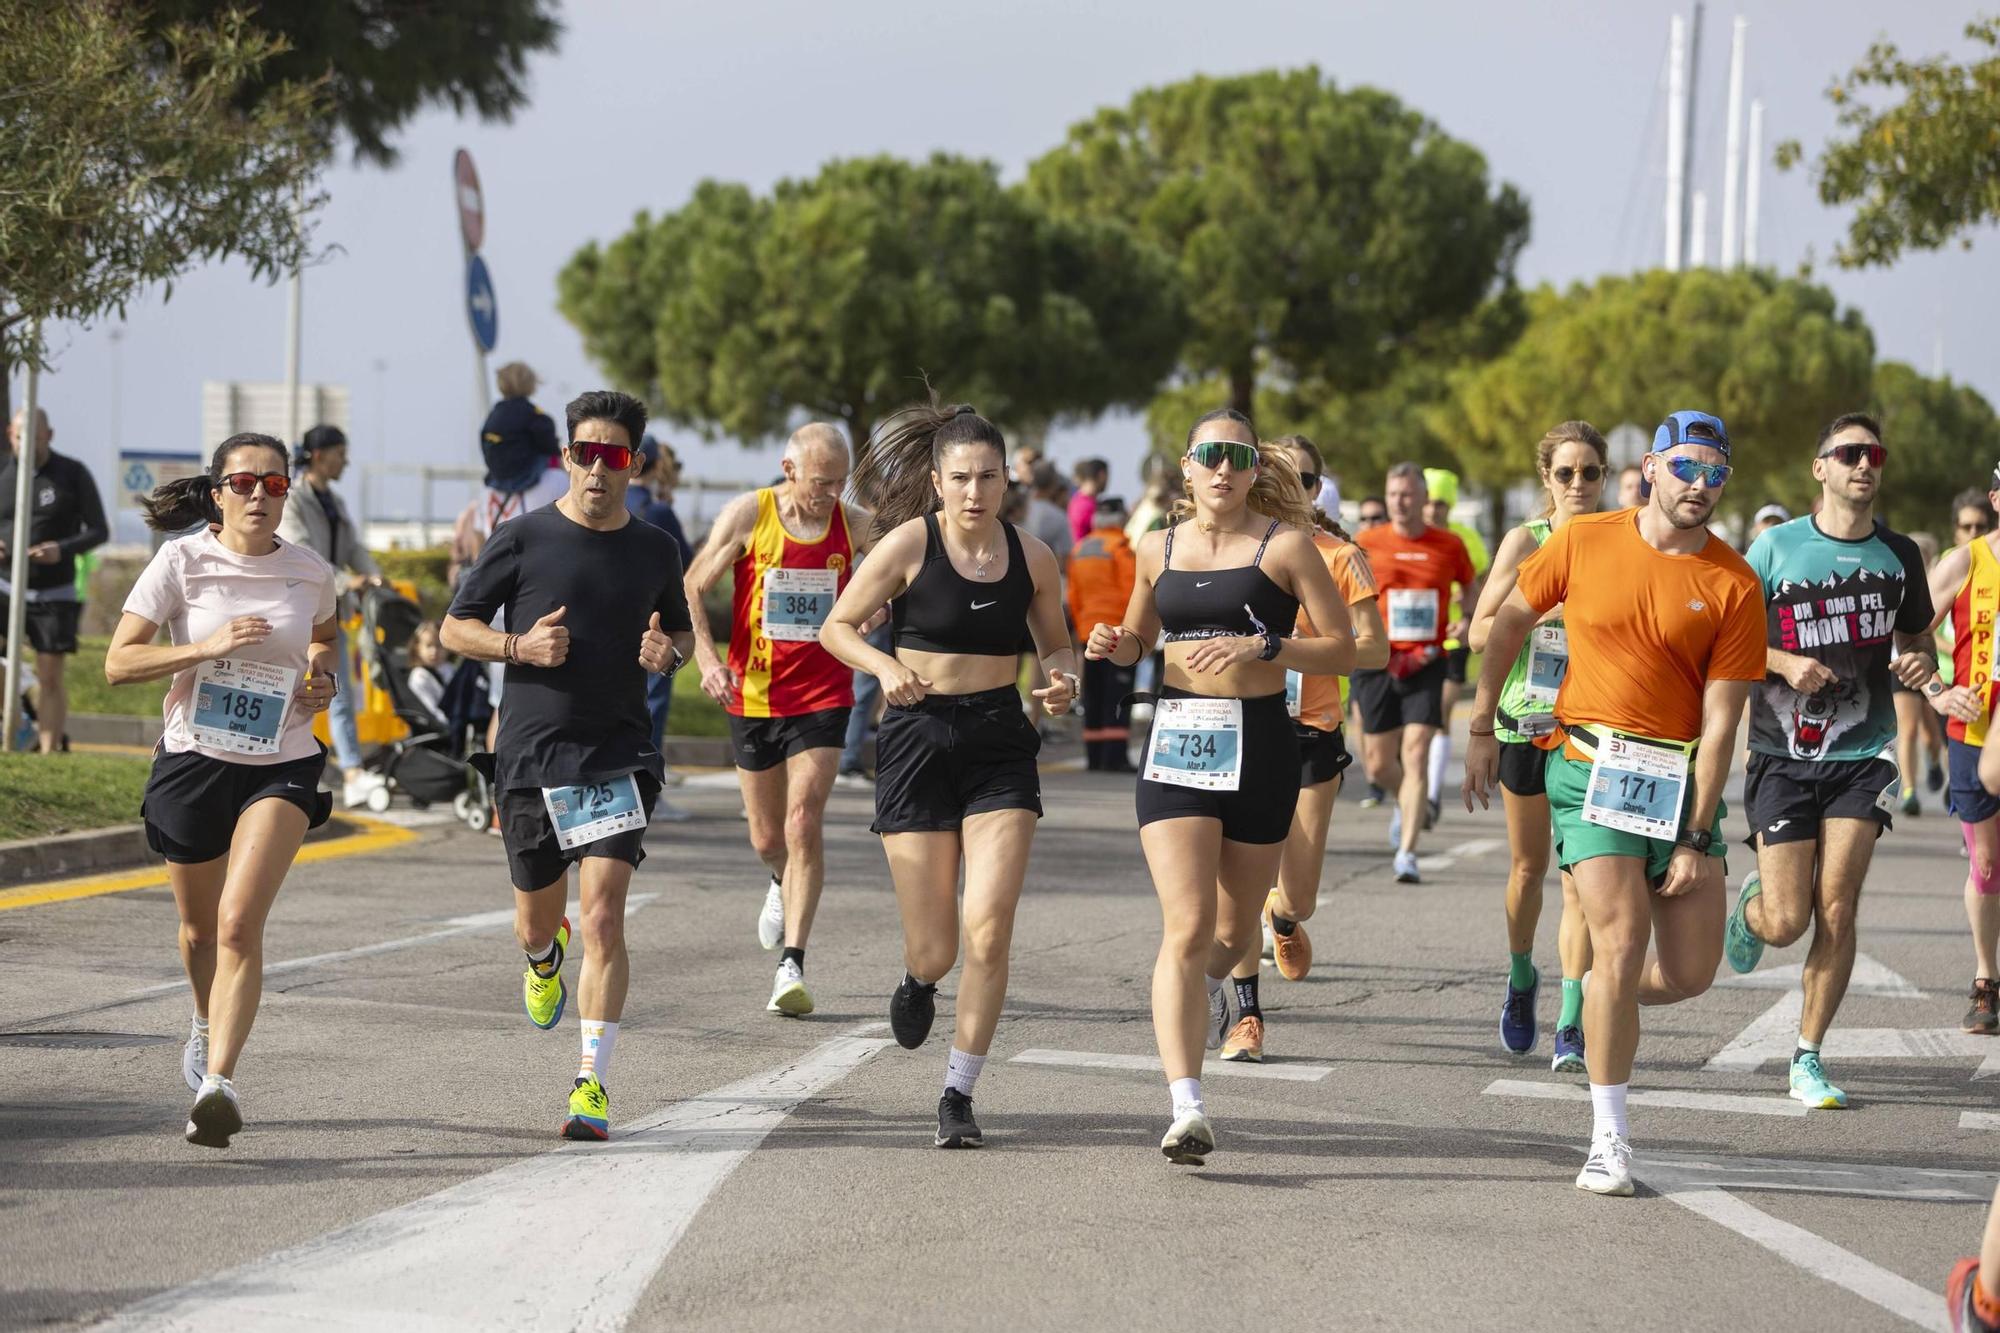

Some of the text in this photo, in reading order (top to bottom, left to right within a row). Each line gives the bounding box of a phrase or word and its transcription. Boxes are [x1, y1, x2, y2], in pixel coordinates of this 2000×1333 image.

[786, 596, 818, 615] 384
[1792, 593, 1885, 621] UN TOMB PEL
[1180, 629, 1210, 638] NIKE
[1543, 629, 1559, 641] 31
[213, 659, 232, 671] 31
[222, 691, 264, 722] 185
[1178, 733, 1217, 758] 734
[1609, 739, 1627, 754] 31
[572, 780, 615, 811] 725
[1620, 774, 1657, 804] 171
[1623, 801, 1647, 815] Charlie
